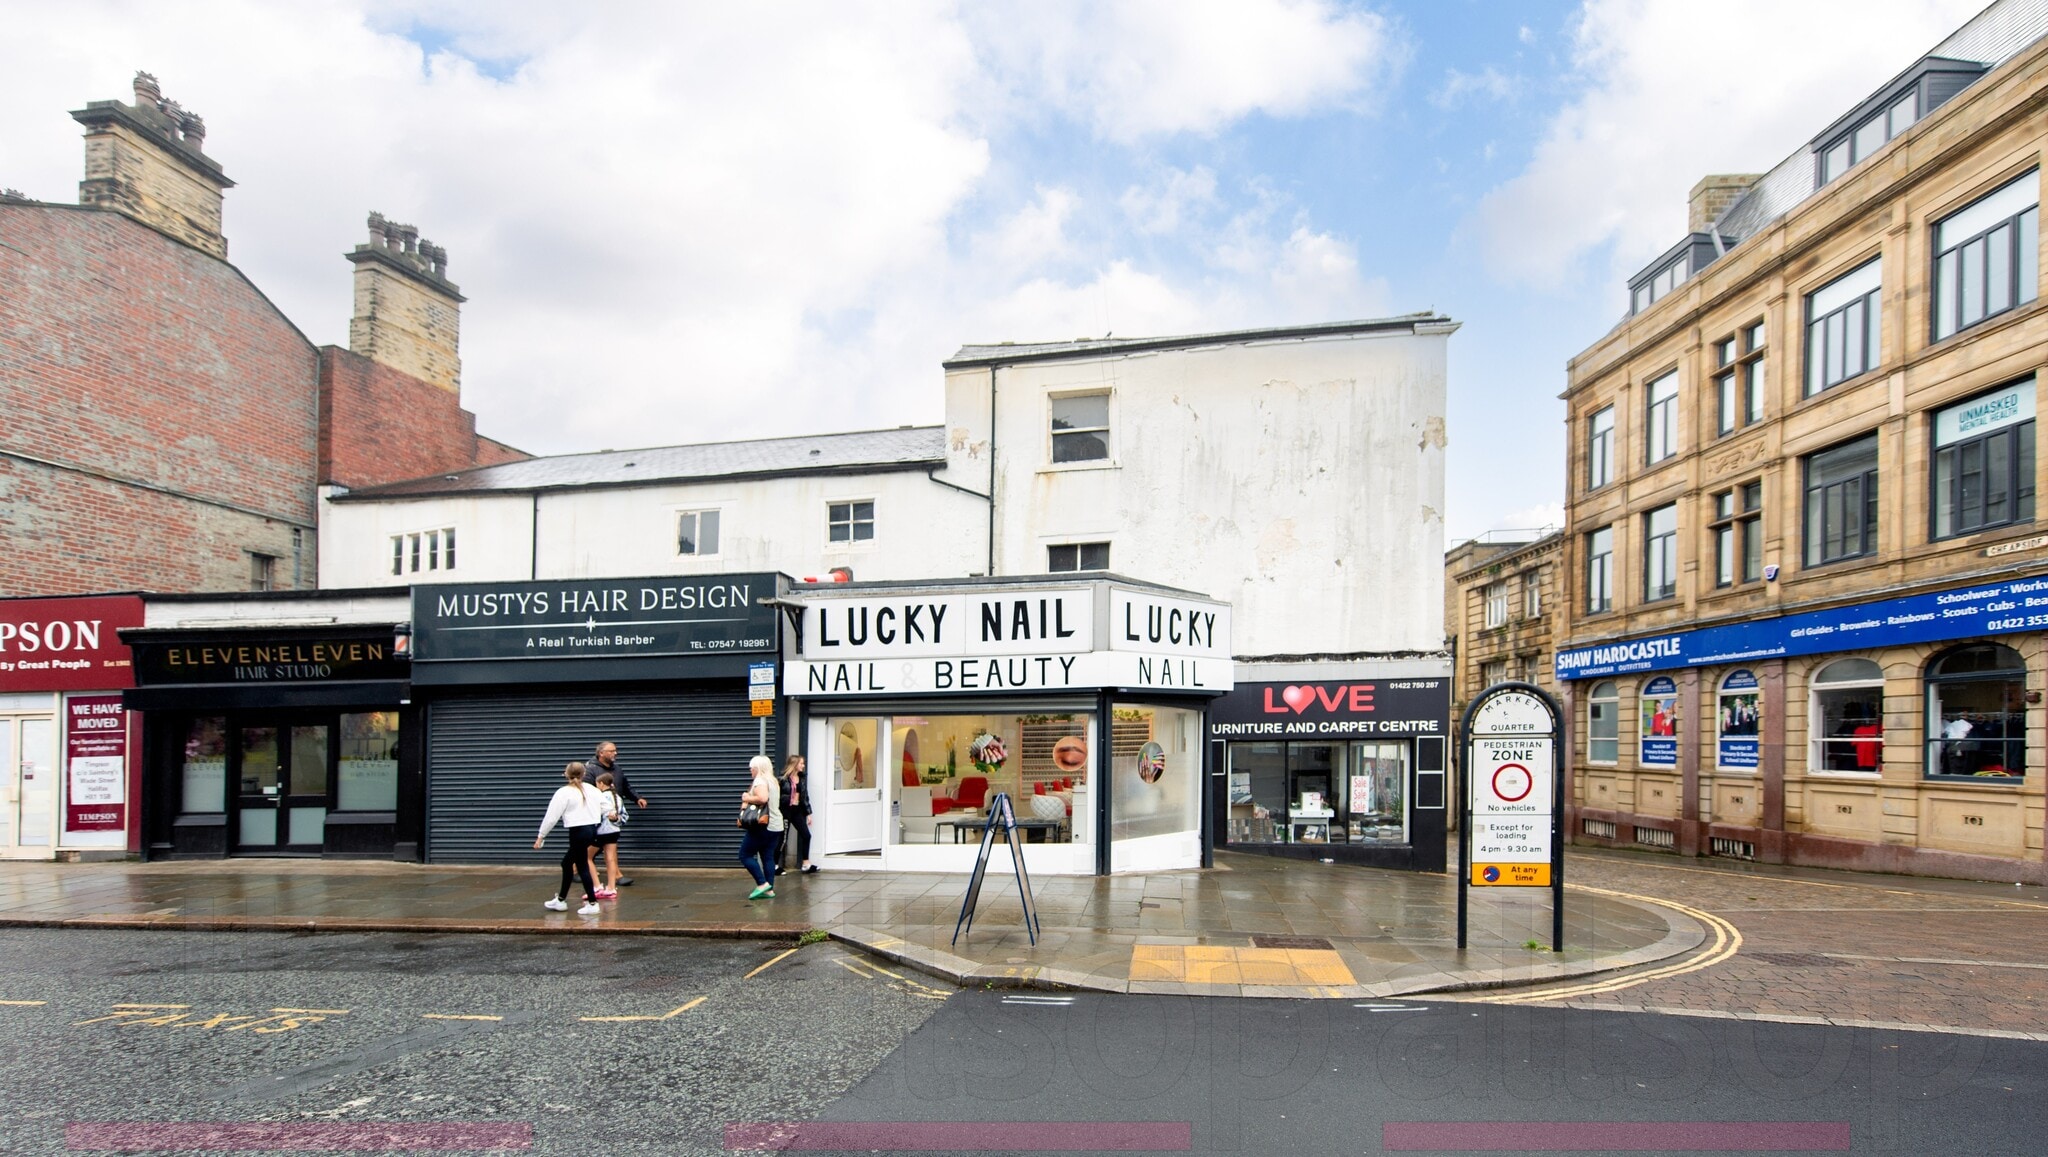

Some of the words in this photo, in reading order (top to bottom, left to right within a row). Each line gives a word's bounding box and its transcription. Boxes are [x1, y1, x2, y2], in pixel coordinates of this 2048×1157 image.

[1959, 393, 2018, 423] UNMASKED
[1960, 418, 1987, 432] MENTAL
[1990, 406, 2018, 421] HEALTH
[437, 591, 549, 617] MUSTYS
[560, 589, 629, 613] HAIR
[640, 584, 750, 610] DESIGN
[1936, 588, 2001, 605] Schoolwear
[820, 604, 947, 647] LUCKY
[981, 598, 1075, 642] NAIL
[1126, 602, 1215, 648] LUCKY
[1790, 627, 1805, 638] Girl
[1806, 625, 1834, 636] Guides
[1840, 619, 1880, 631] Brownies
[1887, 613, 1935, 625] Rainbows
[1942, 605, 1978, 618] Scouts
[1987, 600, 2016, 612] Cubs
[1987, 617, 2025, 630] 01422
[0, 620, 102, 652] PSON
[526, 637, 535, 648] A
[539, 636, 564, 647] Real
[568, 634, 610, 646] Turkish
[615, 634, 655, 646] Barber
[690, 641, 706, 649] TEL:
[708, 640, 736, 648] 07547
[738, 639, 770, 647] 192961
[1557, 650, 1592, 670] SHAW
[1593, 637, 1681, 665] HARDCASTLE
[0, 662, 16, 671] By
[18, 660, 50, 669] Great
[52, 659, 91, 671] People
[234, 665, 269, 680] HAIR
[274, 664, 331, 679] STUDIO
[1139, 656, 1204, 687] NAIL
[1580, 666, 1614, 676] SCHOOLWEAR
[1618, 661, 1652, 672] OUTFITTERS
[808, 663, 886, 692] NAIL
[935, 656, 1076, 690] BEAUTY
[1389, 682, 1411, 690] 01422
[72, 704, 91, 715] WE
[92, 703, 122, 714] HAVE
[1485, 695, 1540, 713] MARKET
[77, 717, 119, 729] MOVED
[1285, 722, 1315, 734] AND
[1318, 721, 1377, 733] CARPET
[1379, 719, 1439, 732] CENTRE
[1490, 723, 1535, 731] QUARTER
[1492, 750, 1533, 760] ZONE
[77, 812, 118, 821] TIMPSON
[1490, 824, 1519, 833] Except
[1496, 832, 1527, 840] loading
